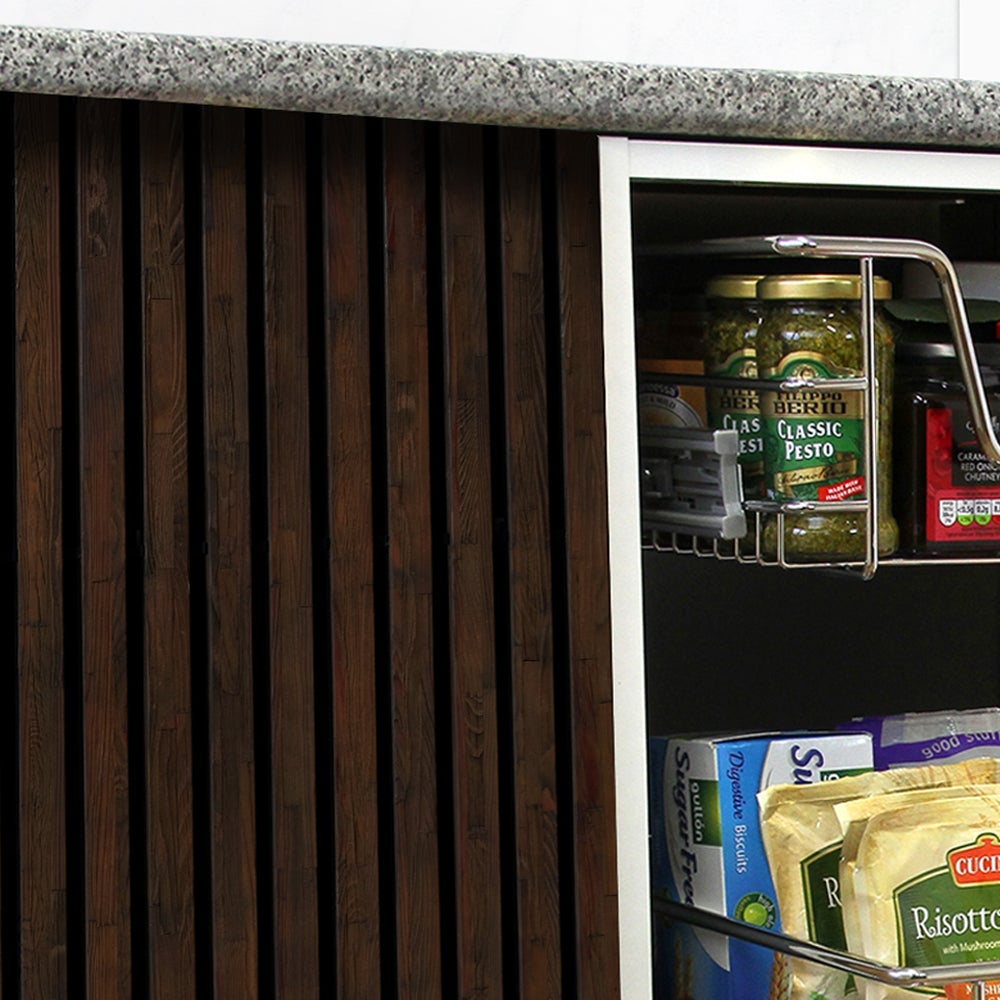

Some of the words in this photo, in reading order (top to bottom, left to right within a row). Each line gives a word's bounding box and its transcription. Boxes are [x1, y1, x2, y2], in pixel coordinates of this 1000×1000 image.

[774, 402, 847, 415] BERIO
[778, 419, 842, 440] CLASSIC
[785, 440, 834, 460] PESTO
[921, 734, 960, 759] good
[669, 746, 691, 849] Sugar
[725, 751, 745, 820] Digestive
[735, 824, 748, 874] Biscuits
